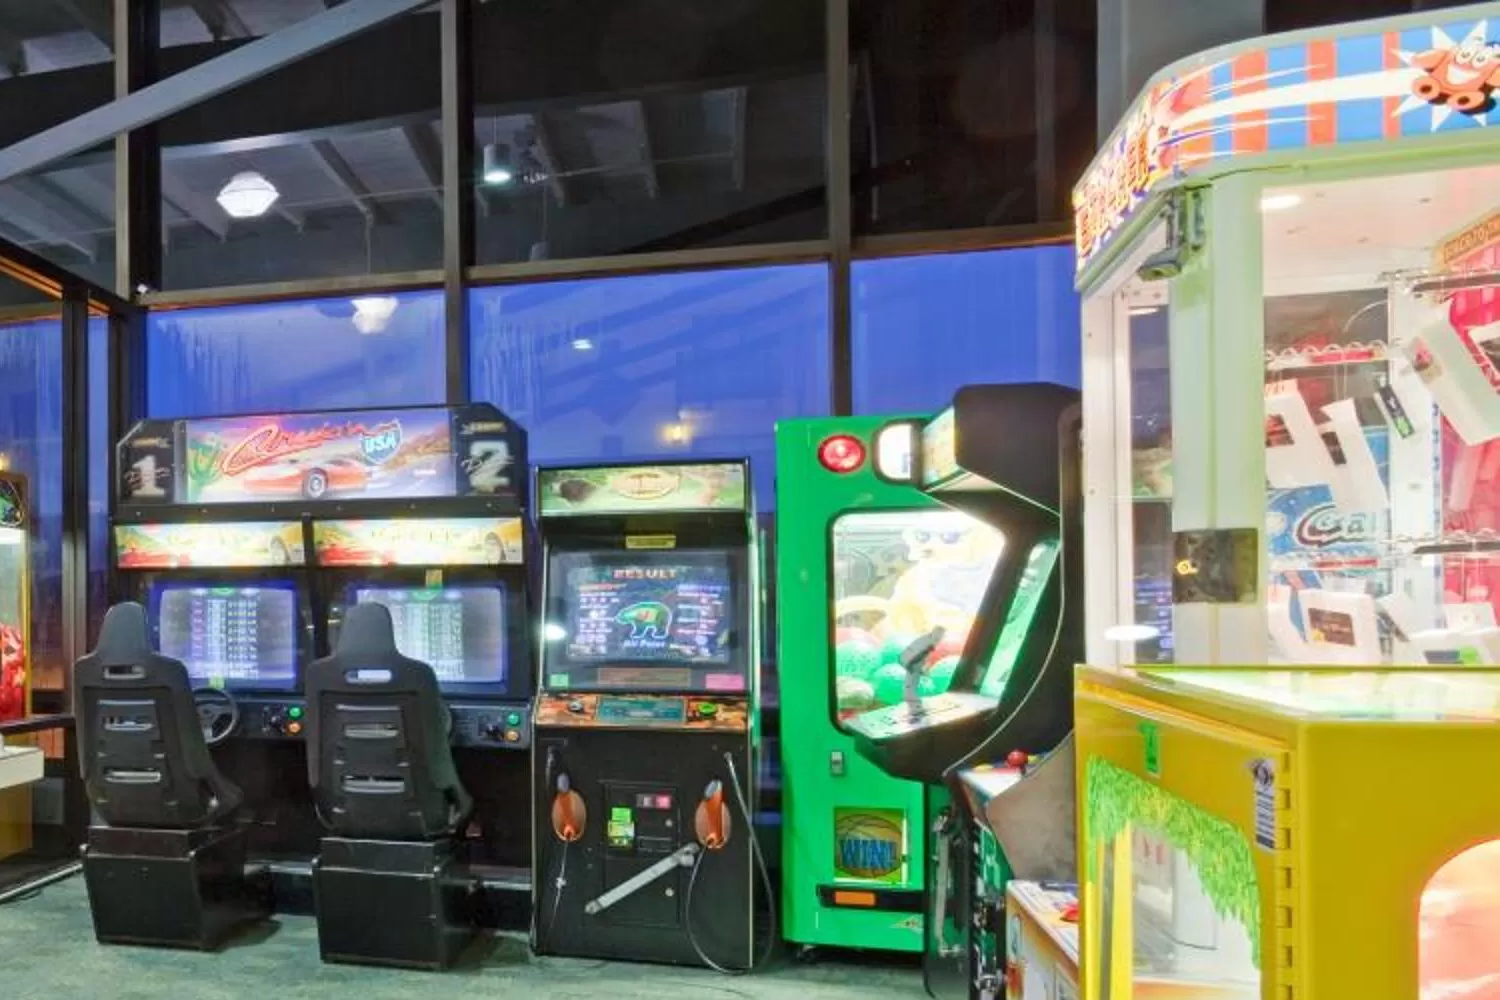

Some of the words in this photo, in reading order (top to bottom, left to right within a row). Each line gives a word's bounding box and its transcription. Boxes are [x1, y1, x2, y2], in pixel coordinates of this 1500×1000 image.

[365, 431, 398, 452] USA
[132, 455, 166, 497] 1
[469, 440, 510, 490] 2
